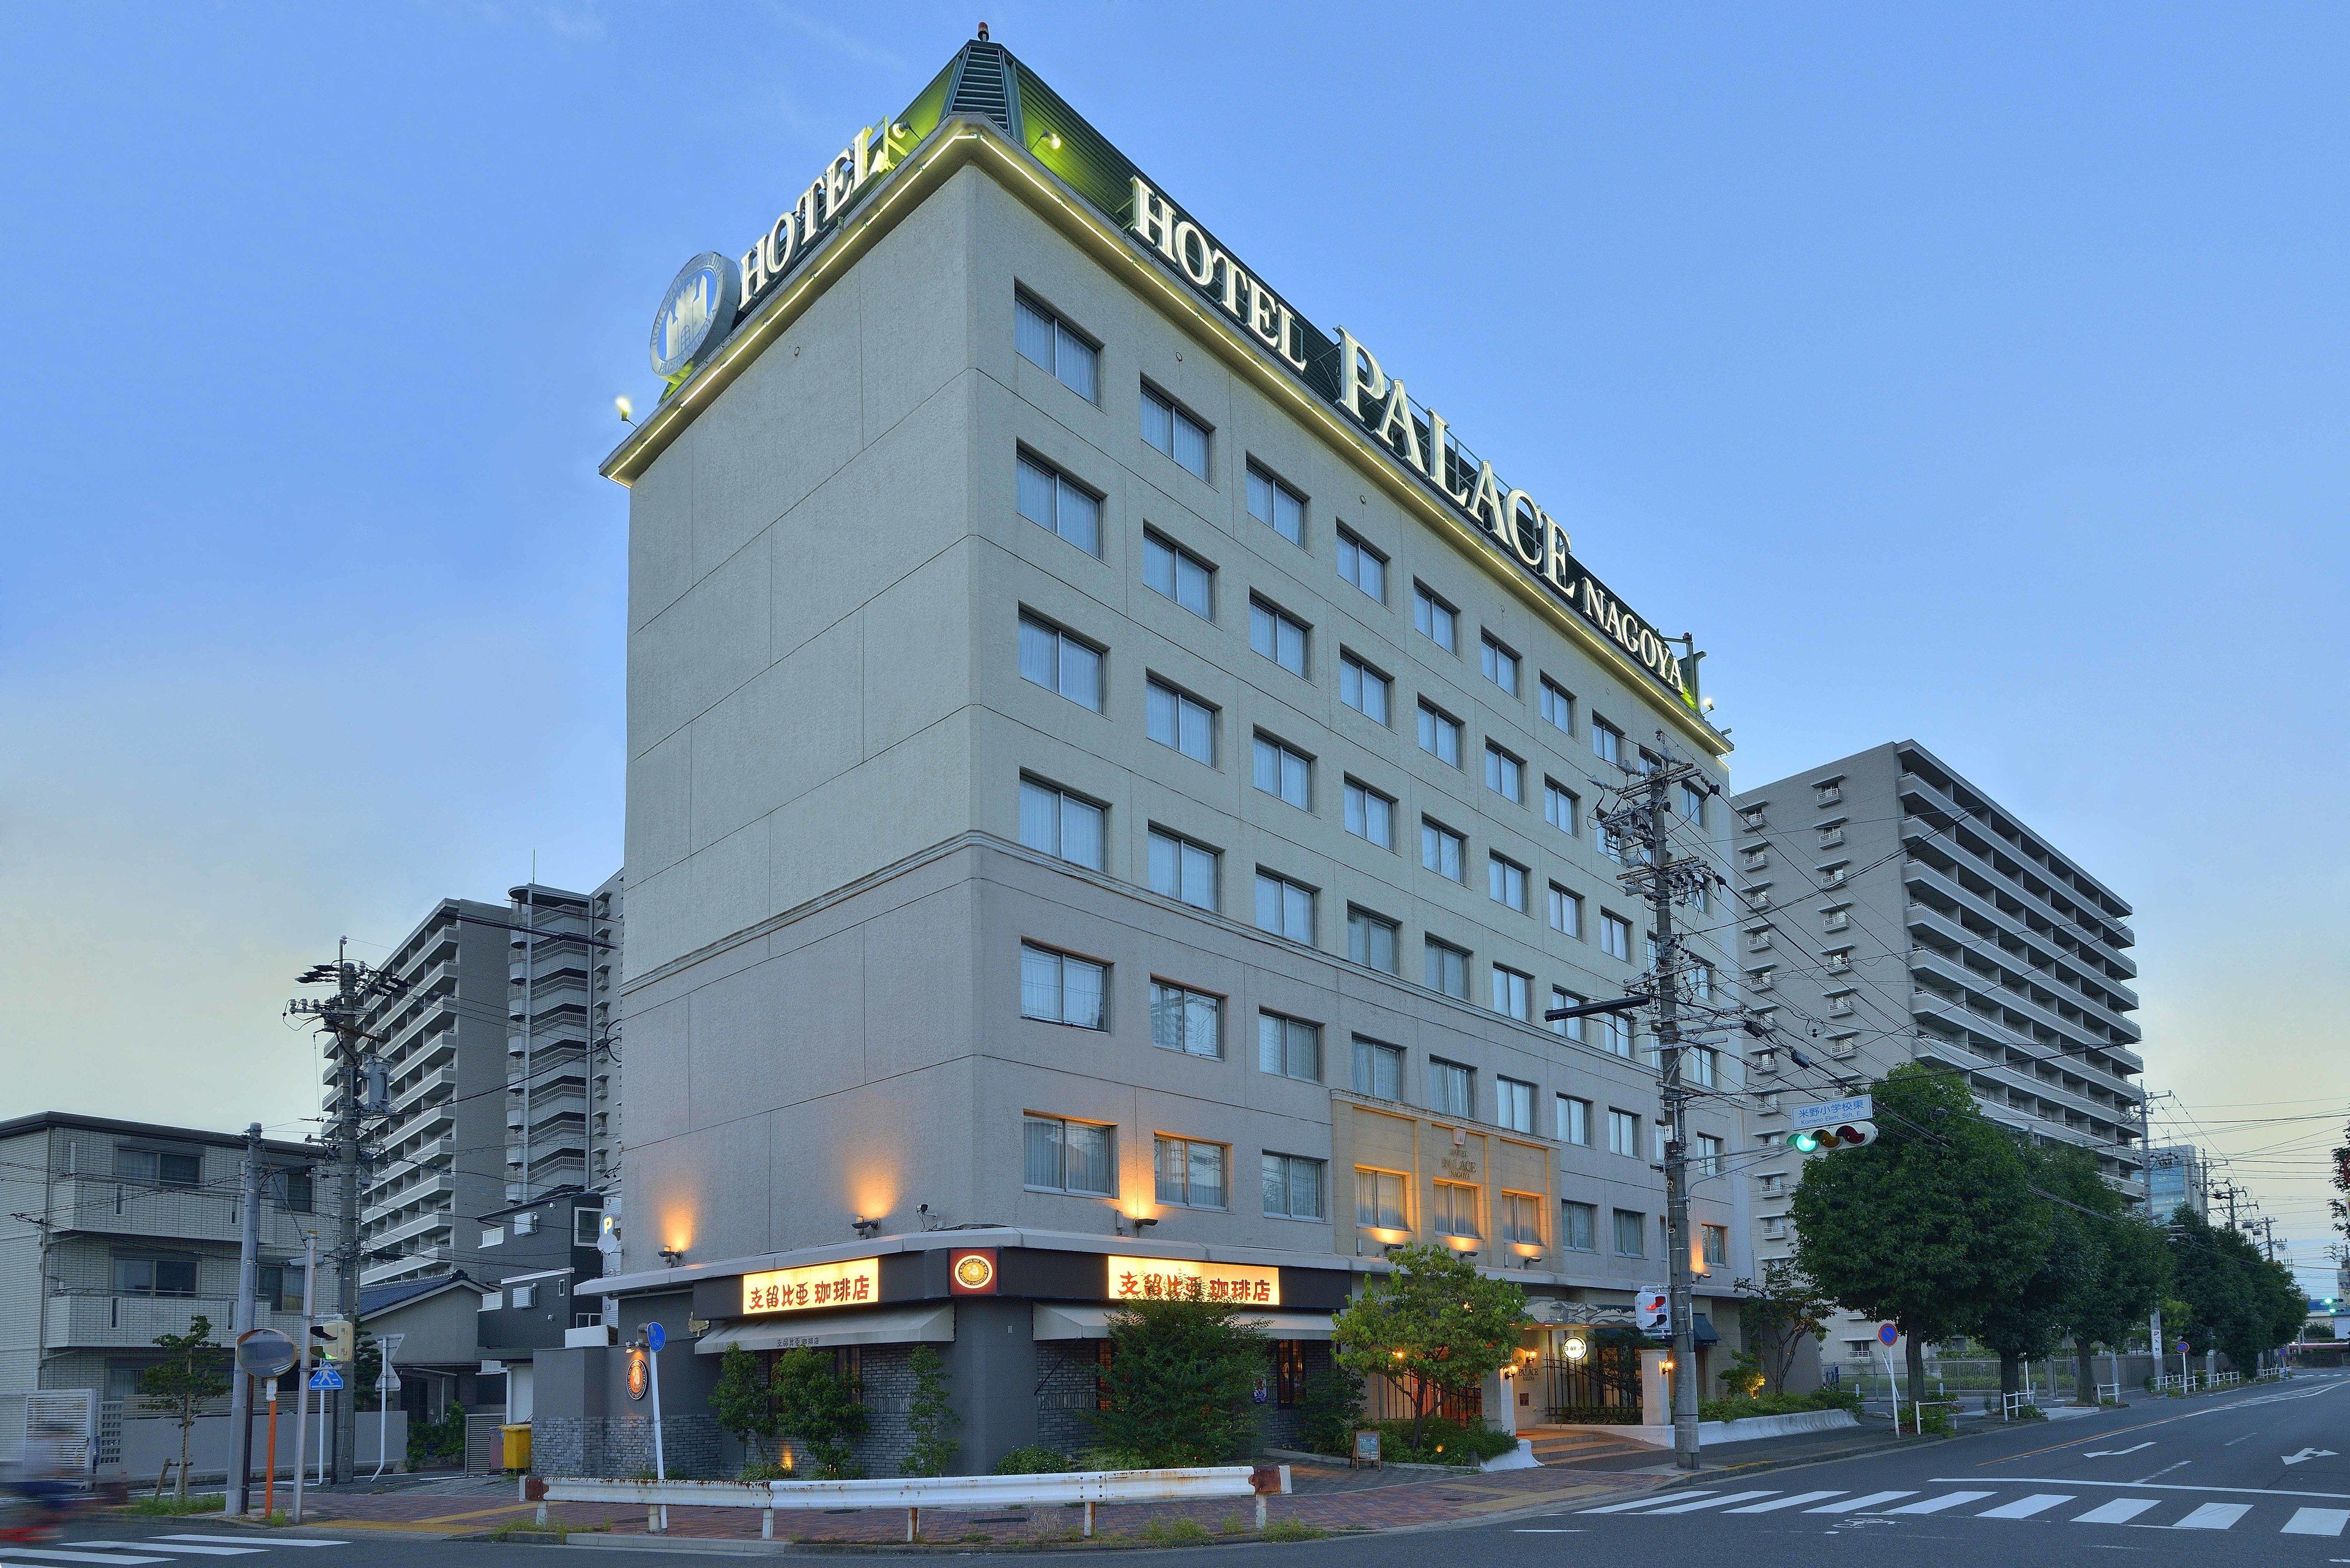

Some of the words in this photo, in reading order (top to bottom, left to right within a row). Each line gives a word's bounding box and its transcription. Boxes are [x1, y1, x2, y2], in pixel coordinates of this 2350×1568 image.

[739, 126, 886, 311] HOTEL
[1130, 176, 1307, 371] HOTEL
[1334, 325, 1575, 597] PALACE
[1582, 576, 1684, 693] NAGOYA
[1799, 1100, 1864, 1118] 米野小学校東
[1450, 1170, 1470, 1179] NAGOYA
[604, 1217, 612, 1234] P
